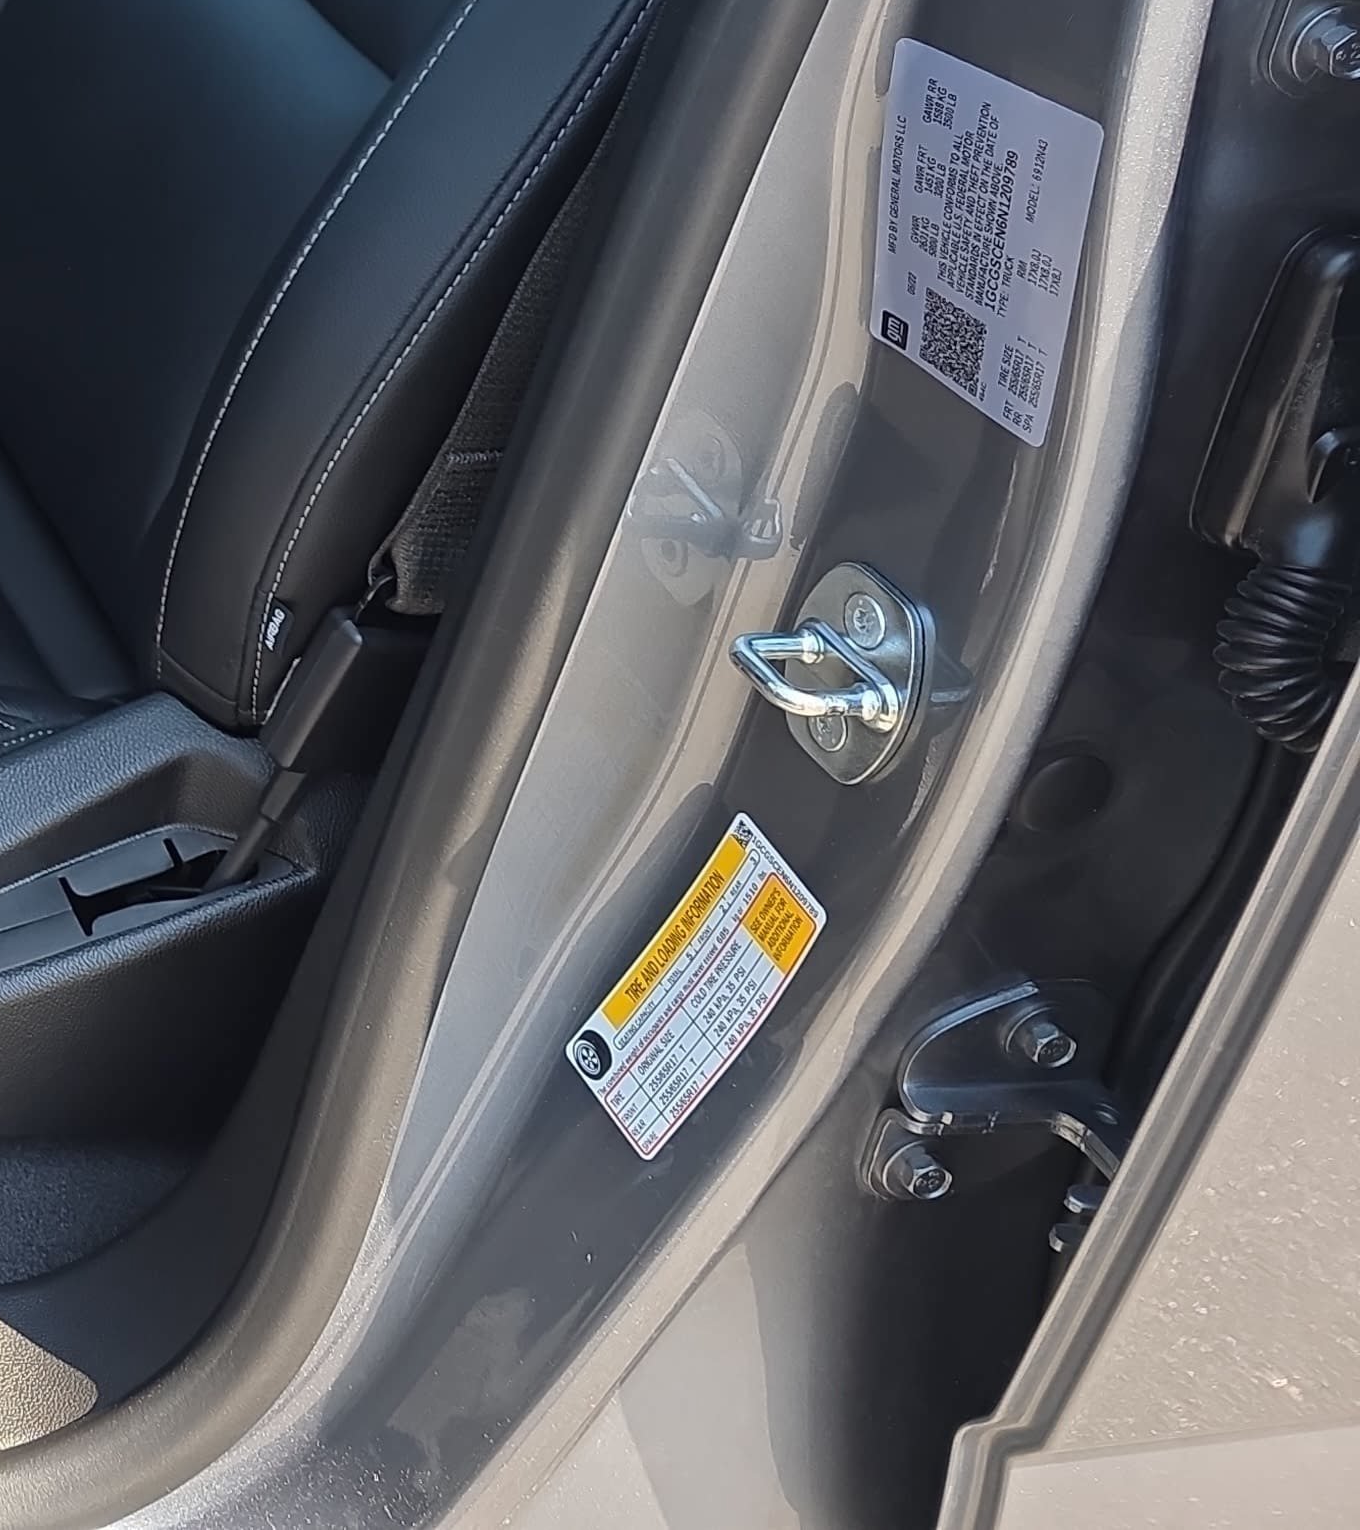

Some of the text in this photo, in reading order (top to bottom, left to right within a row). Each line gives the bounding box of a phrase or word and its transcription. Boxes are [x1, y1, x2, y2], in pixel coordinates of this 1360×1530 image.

[922, 76, 937, 125] GAWR RR
[936, 85, 947, 103] KG
[946, 91, 956, 107] LB
[914, 143, 927, 195] GAWR FRT
[926, 155, 936, 172] KG
[936, 162, 946, 177] LB
[887, 113, 906, 254] MFD BY GENERAL MOTORS LLC
[1024, 137, 1048, 223] MODEL: 6912N43
[937, 130, 963, 282] THIS VEHICLE CONFORMS TO ALL
[945, 129, 974, 288] APPLICABLE U.S. FEDERAL MOTOR
[955, 99, 991, 295] VEHICLE SAFETY AND THEFT PREVENTION
[964, 114, 999, 301] STANDARDS IN EFFECT ON THE DATE OF
[909, 213, 921, 245] GVWR
[920, 215, 930, 232] KG
[930, 221, 939, 237] LB
[974, 234, 992, 306] MANUFACTURE
[984, 197, 997, 235] SHOWN
[997, 253, 1015, 318] TYPE: TRUCK
[886, 314, 904, 345] gm
[997, 342, 1013, 389] TIRE SIZE
[1002, 398, 1014, 421] FRT
[1012, 409, 1022, 427] RR
[1022, 411, 1034, 434] SPA
[773, 896, 788, 915] FOR
[623, 975, 646, 1005] TIRE
[638, 957, 660, 986] AND
[652, 921, 687, 968] LOADING
[678, 868, 726, 931] INFORMATION
[763, 907, 796, 950] ADDITIONAL
[769, 913, 806, 962] INFORMATION
[689, 985, 708, 1010] COLD
[703, 971, 718, 991] TIRE
[712, 938, 742, 978] PRESSURE
[724, 979, 736, 994] 35
[732, 964, 746, 983] PSI
[735, 992, 747, 1007] 35
[743, 977, 757, 996] PSI
[746, 1005, 758, 1020] 35
[754, 990, 769, 1009] PSI
[658, 1027, 675, 1049] SIZE
